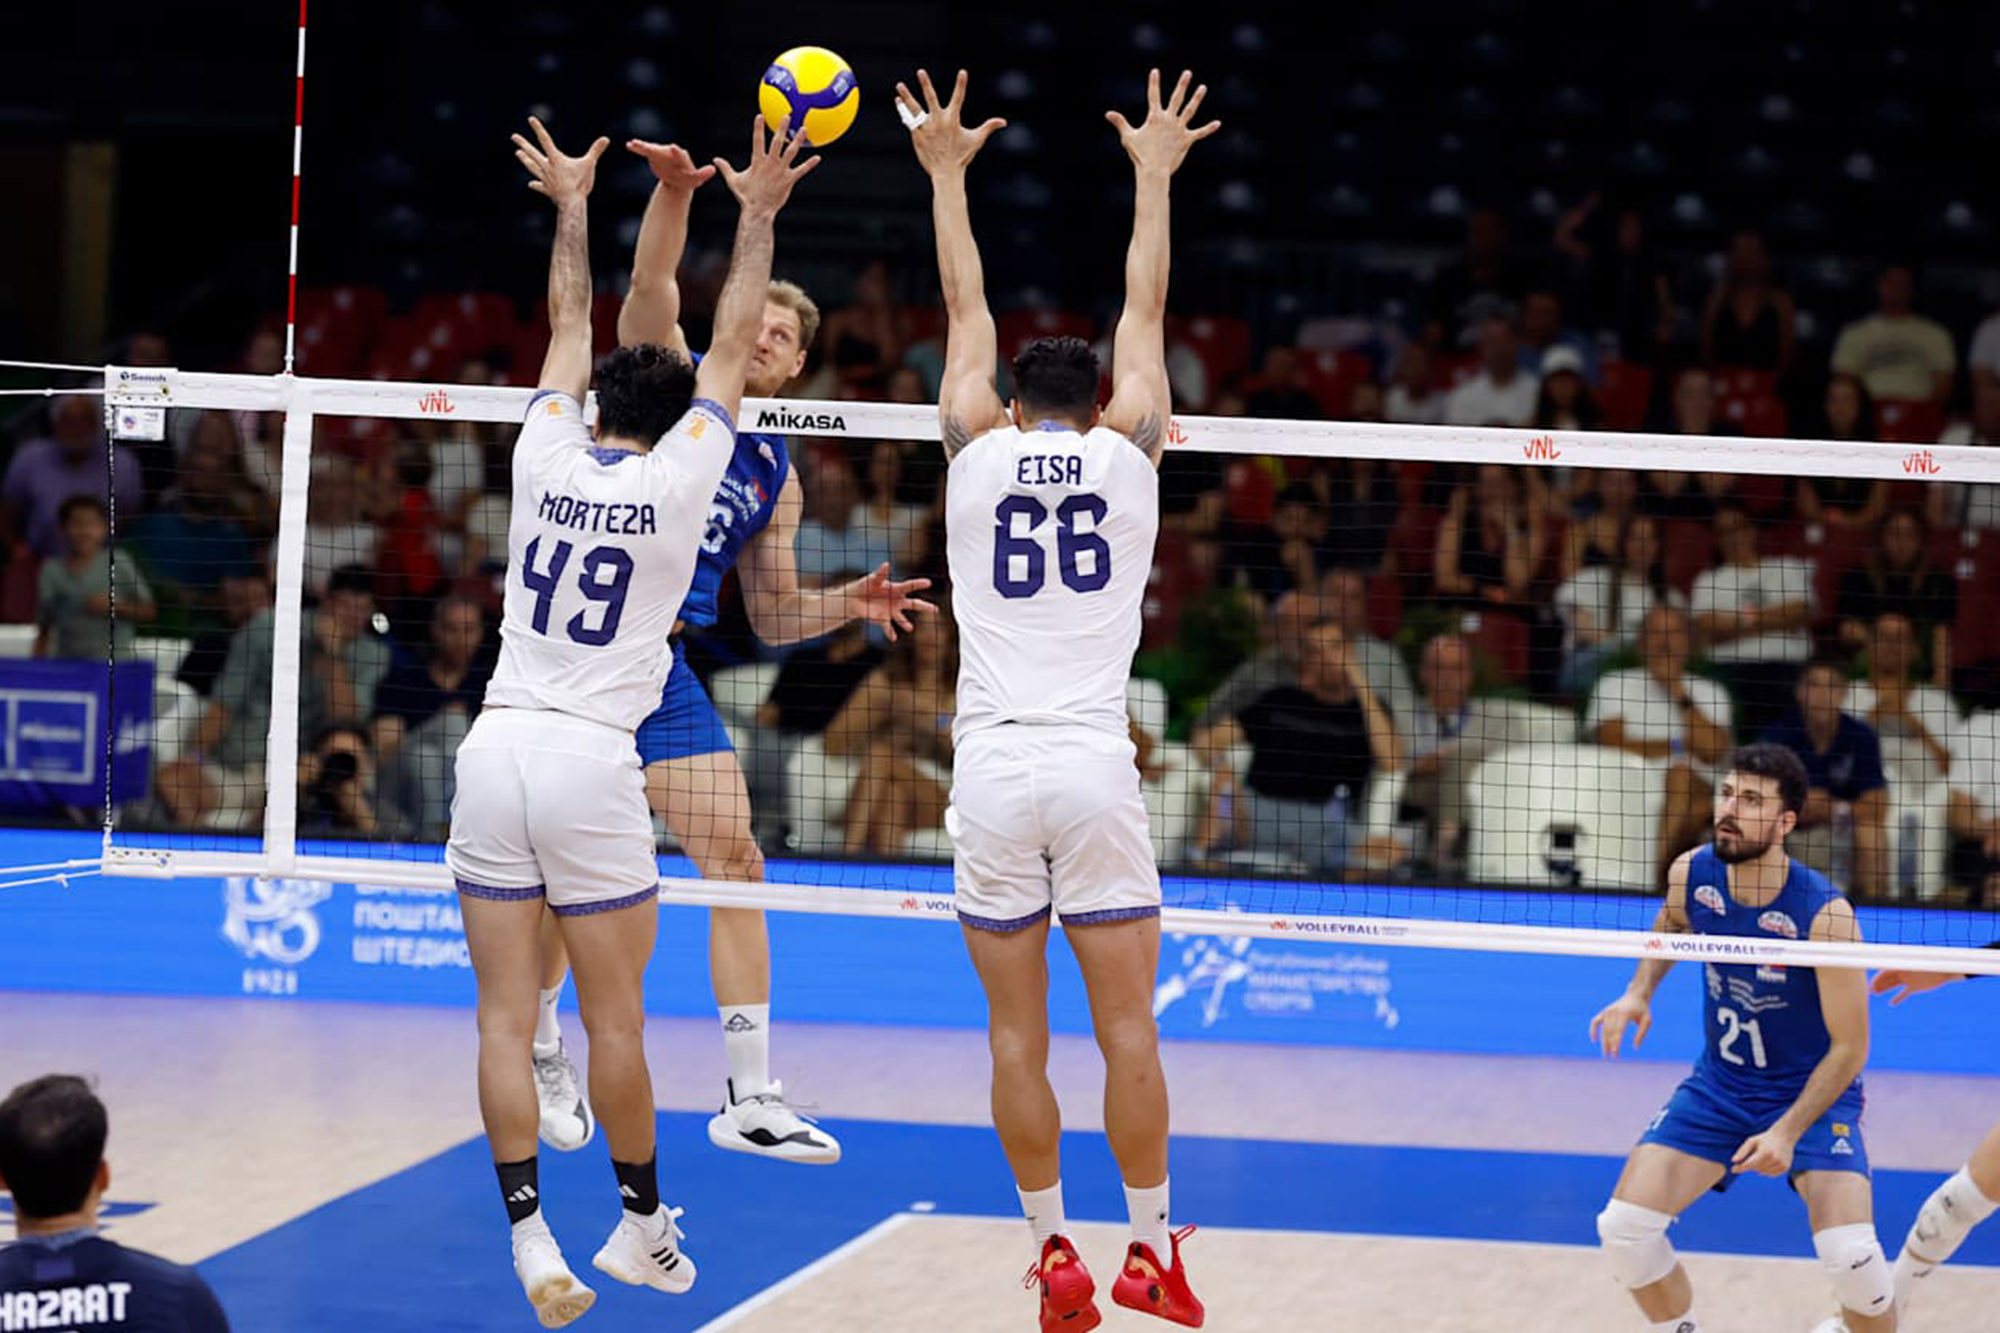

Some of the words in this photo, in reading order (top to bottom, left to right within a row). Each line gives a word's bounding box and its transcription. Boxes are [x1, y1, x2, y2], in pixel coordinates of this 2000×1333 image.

[1523, 434, 1561, 460] VNL
[1902, 449, 1941, 474] VNL
[1017, 454, 1083, 486] EISA
[538, 489, 657, 535] MORTEZA
[993, 492, 1112, 600] 66
[522, 533, 635, 648] 49
[1296, 922, 1379, 936] VOLLEYBALL
[1671, 942, 1755, 955] VOLLEYBALL
[1717, 1006, 1767, 1069] 21
